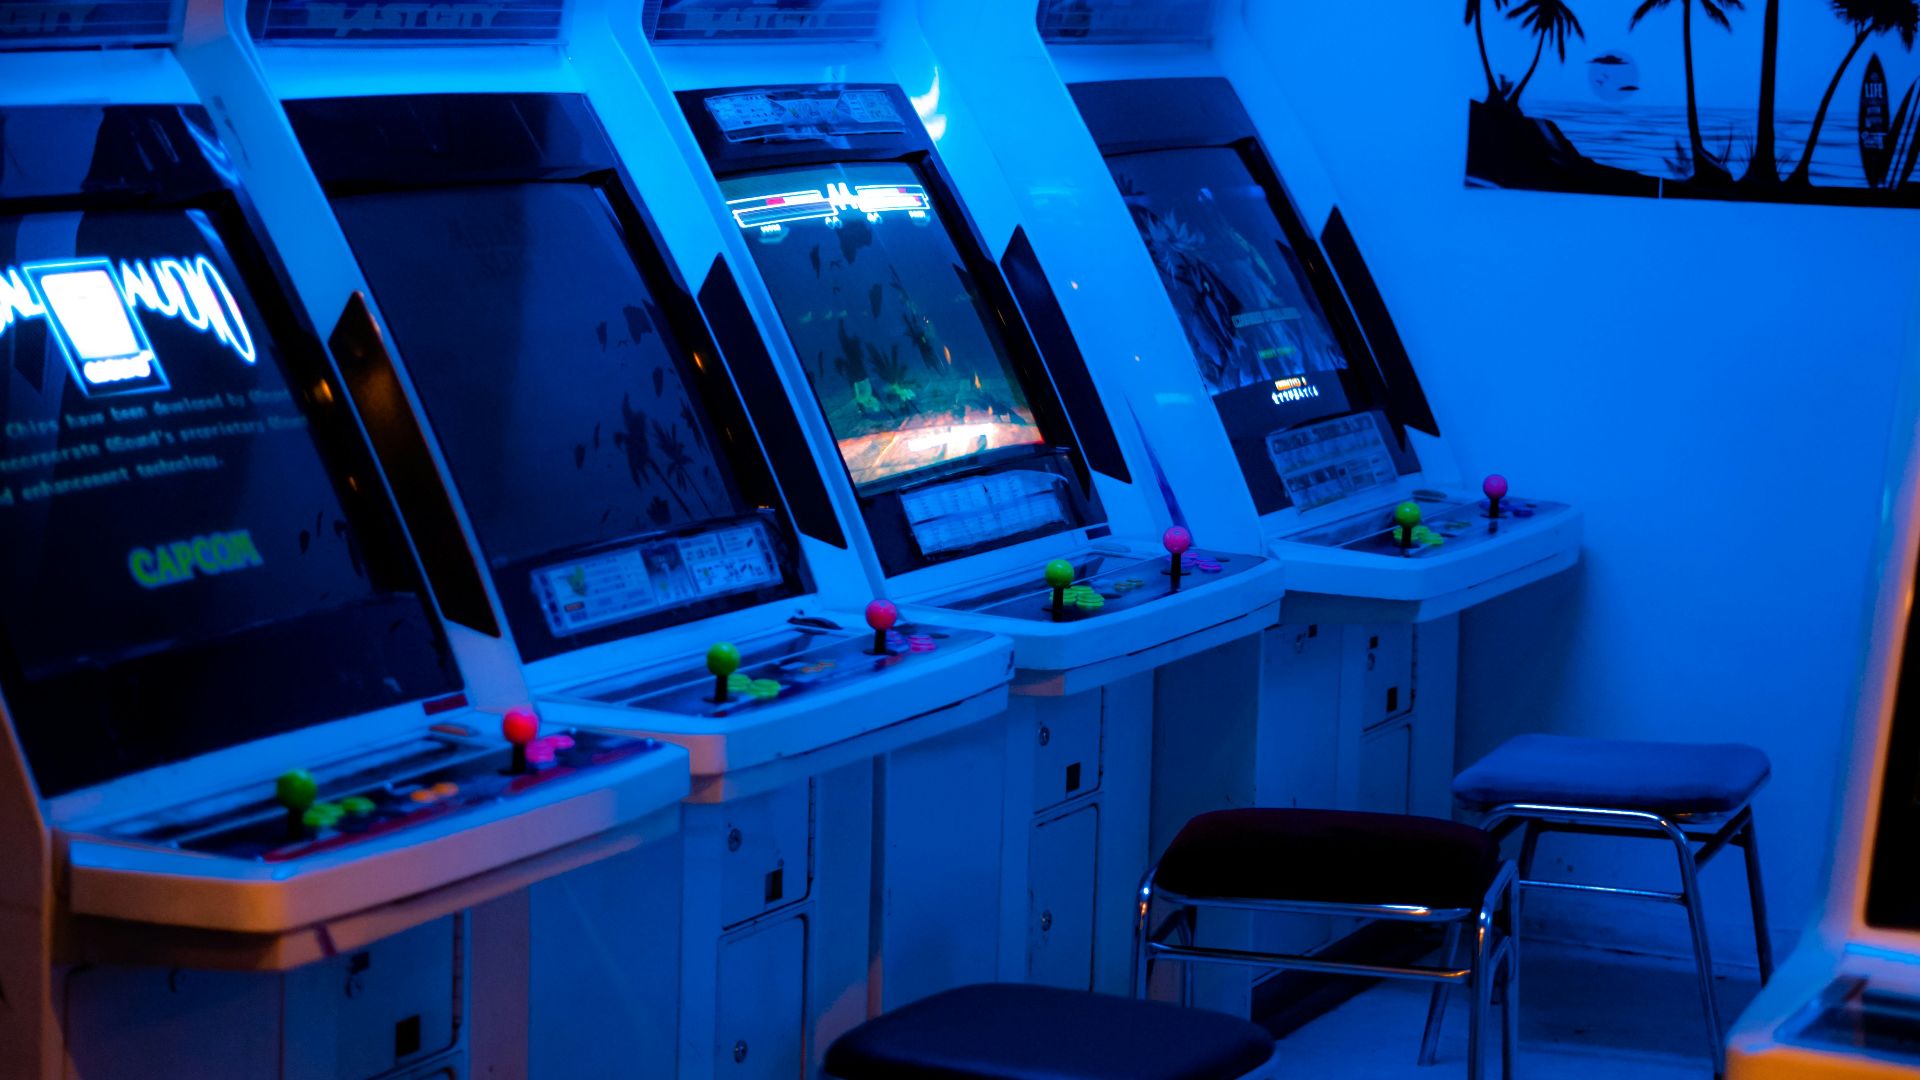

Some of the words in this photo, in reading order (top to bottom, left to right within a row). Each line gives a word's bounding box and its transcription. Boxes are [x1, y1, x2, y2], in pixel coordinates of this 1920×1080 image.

[65, 412, 105, 429] have
[110, 406, 148, 421] been
[153, 394, 223, 416] developed
[128, 528, 265, 589] CAPCOM
